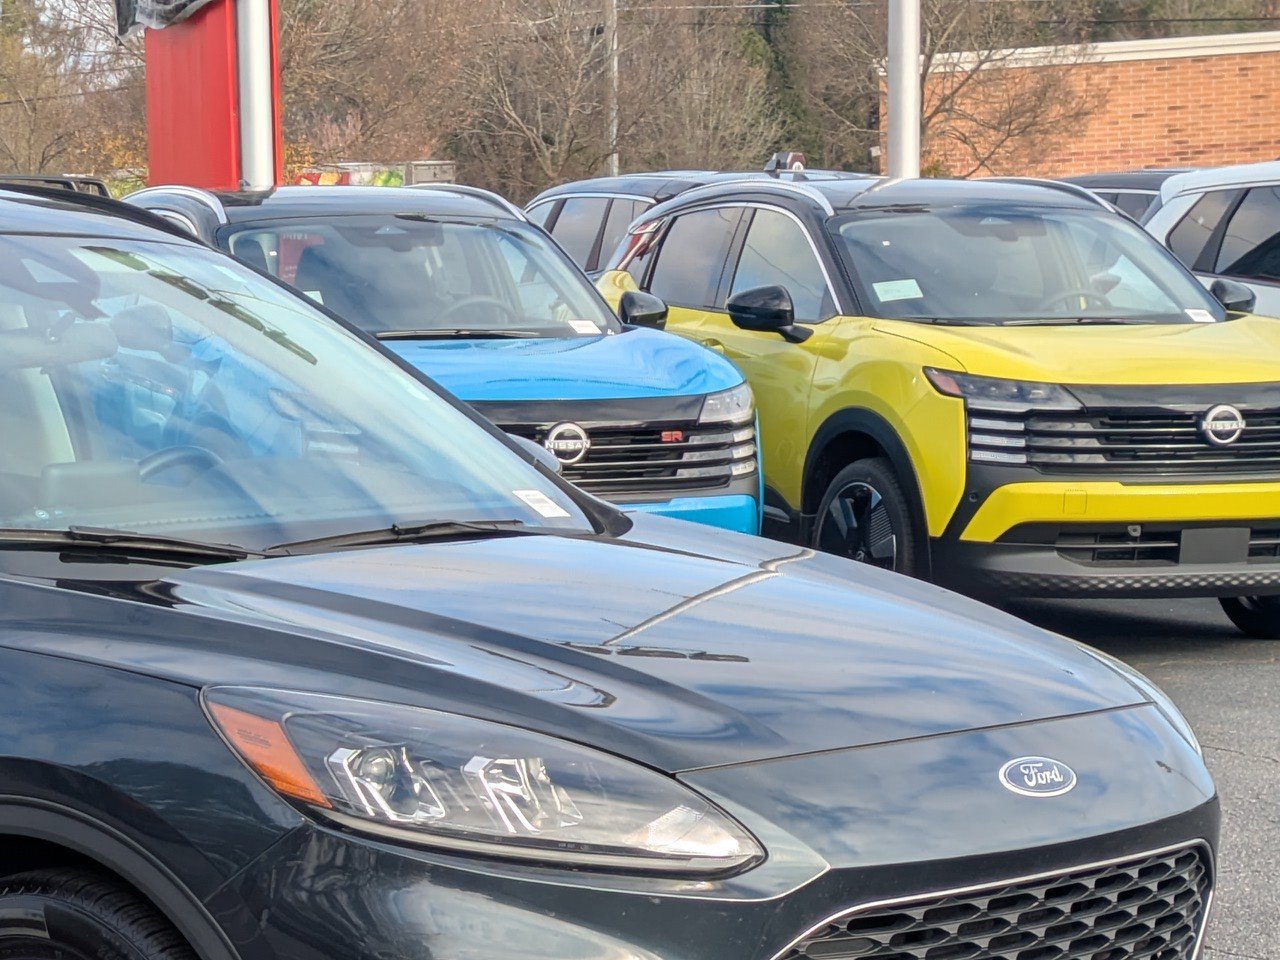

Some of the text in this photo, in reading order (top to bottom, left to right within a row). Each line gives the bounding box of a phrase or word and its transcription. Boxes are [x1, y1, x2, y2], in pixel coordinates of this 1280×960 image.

[661, 430, 682, 441] SR
[545, 440, 590, 449] NISSAN
[1019, 763, 1064, 787] Ford
